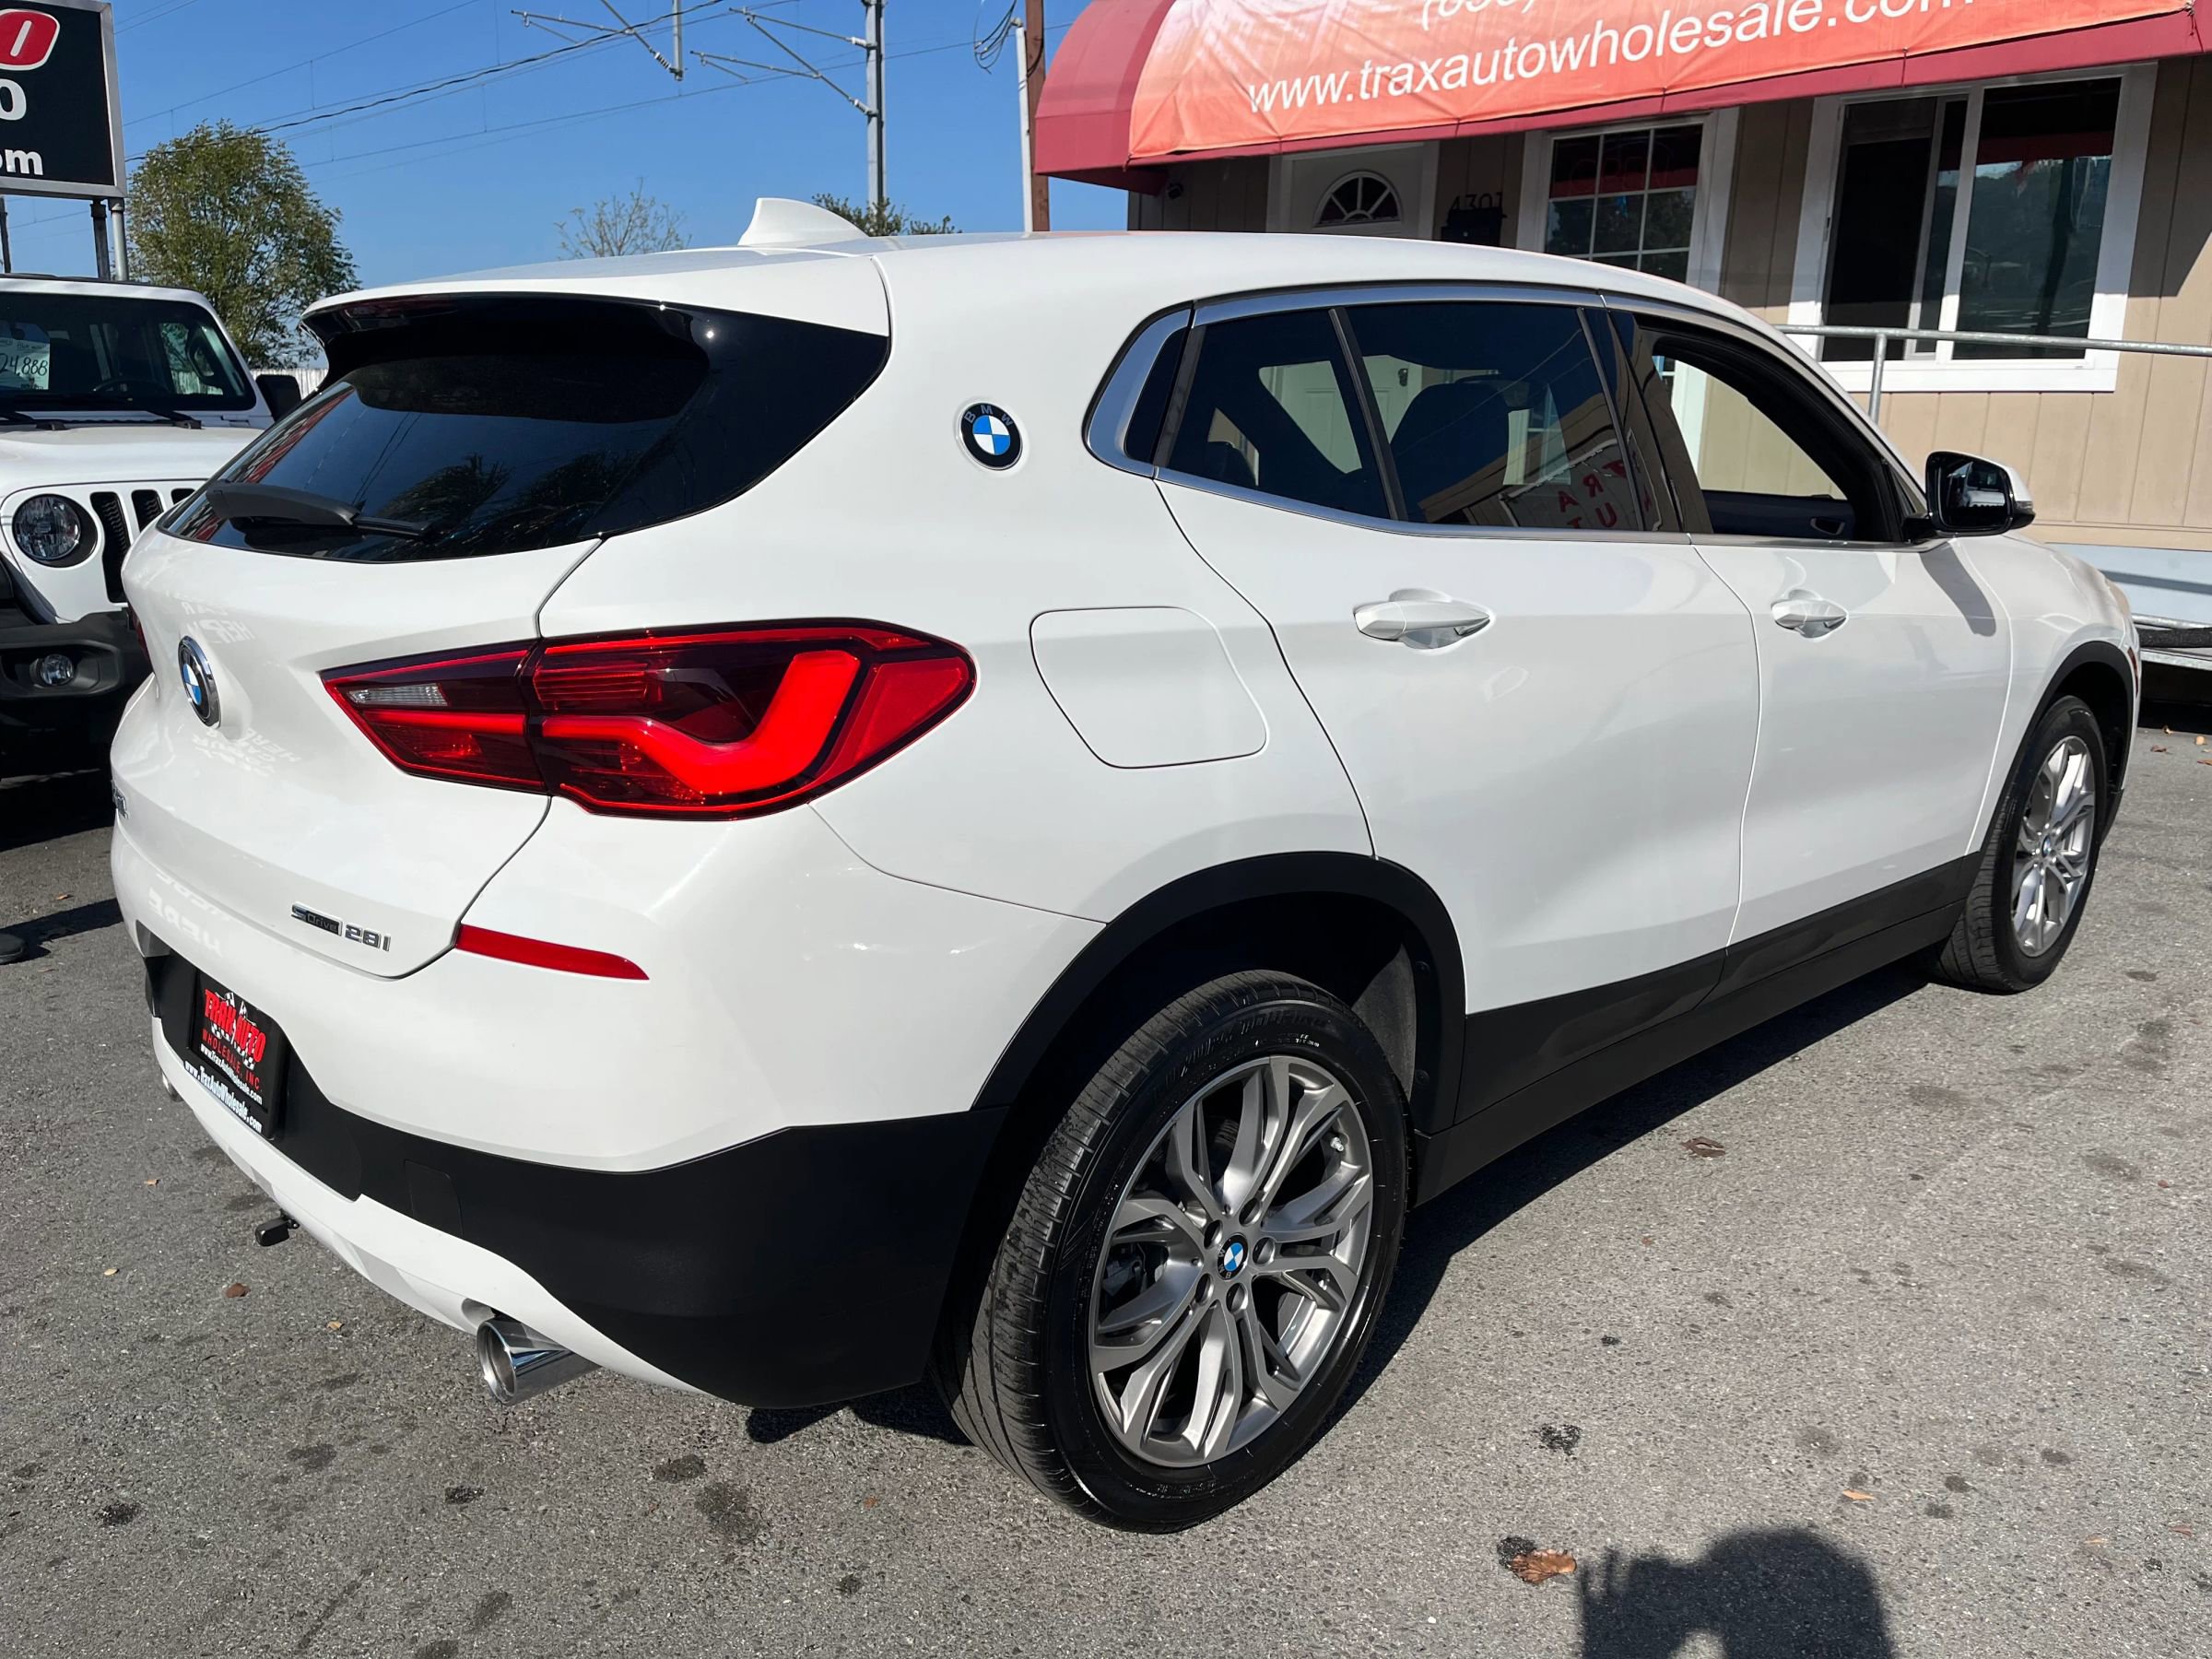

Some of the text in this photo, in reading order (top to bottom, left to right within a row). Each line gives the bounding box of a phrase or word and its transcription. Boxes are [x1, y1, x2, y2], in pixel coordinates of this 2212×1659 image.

[1249, 0, 1973, 113] www.traxautowholesale.co
[964, 404, 1014, 427] BMW
[234, 1015, 266, 1063] AUTO
